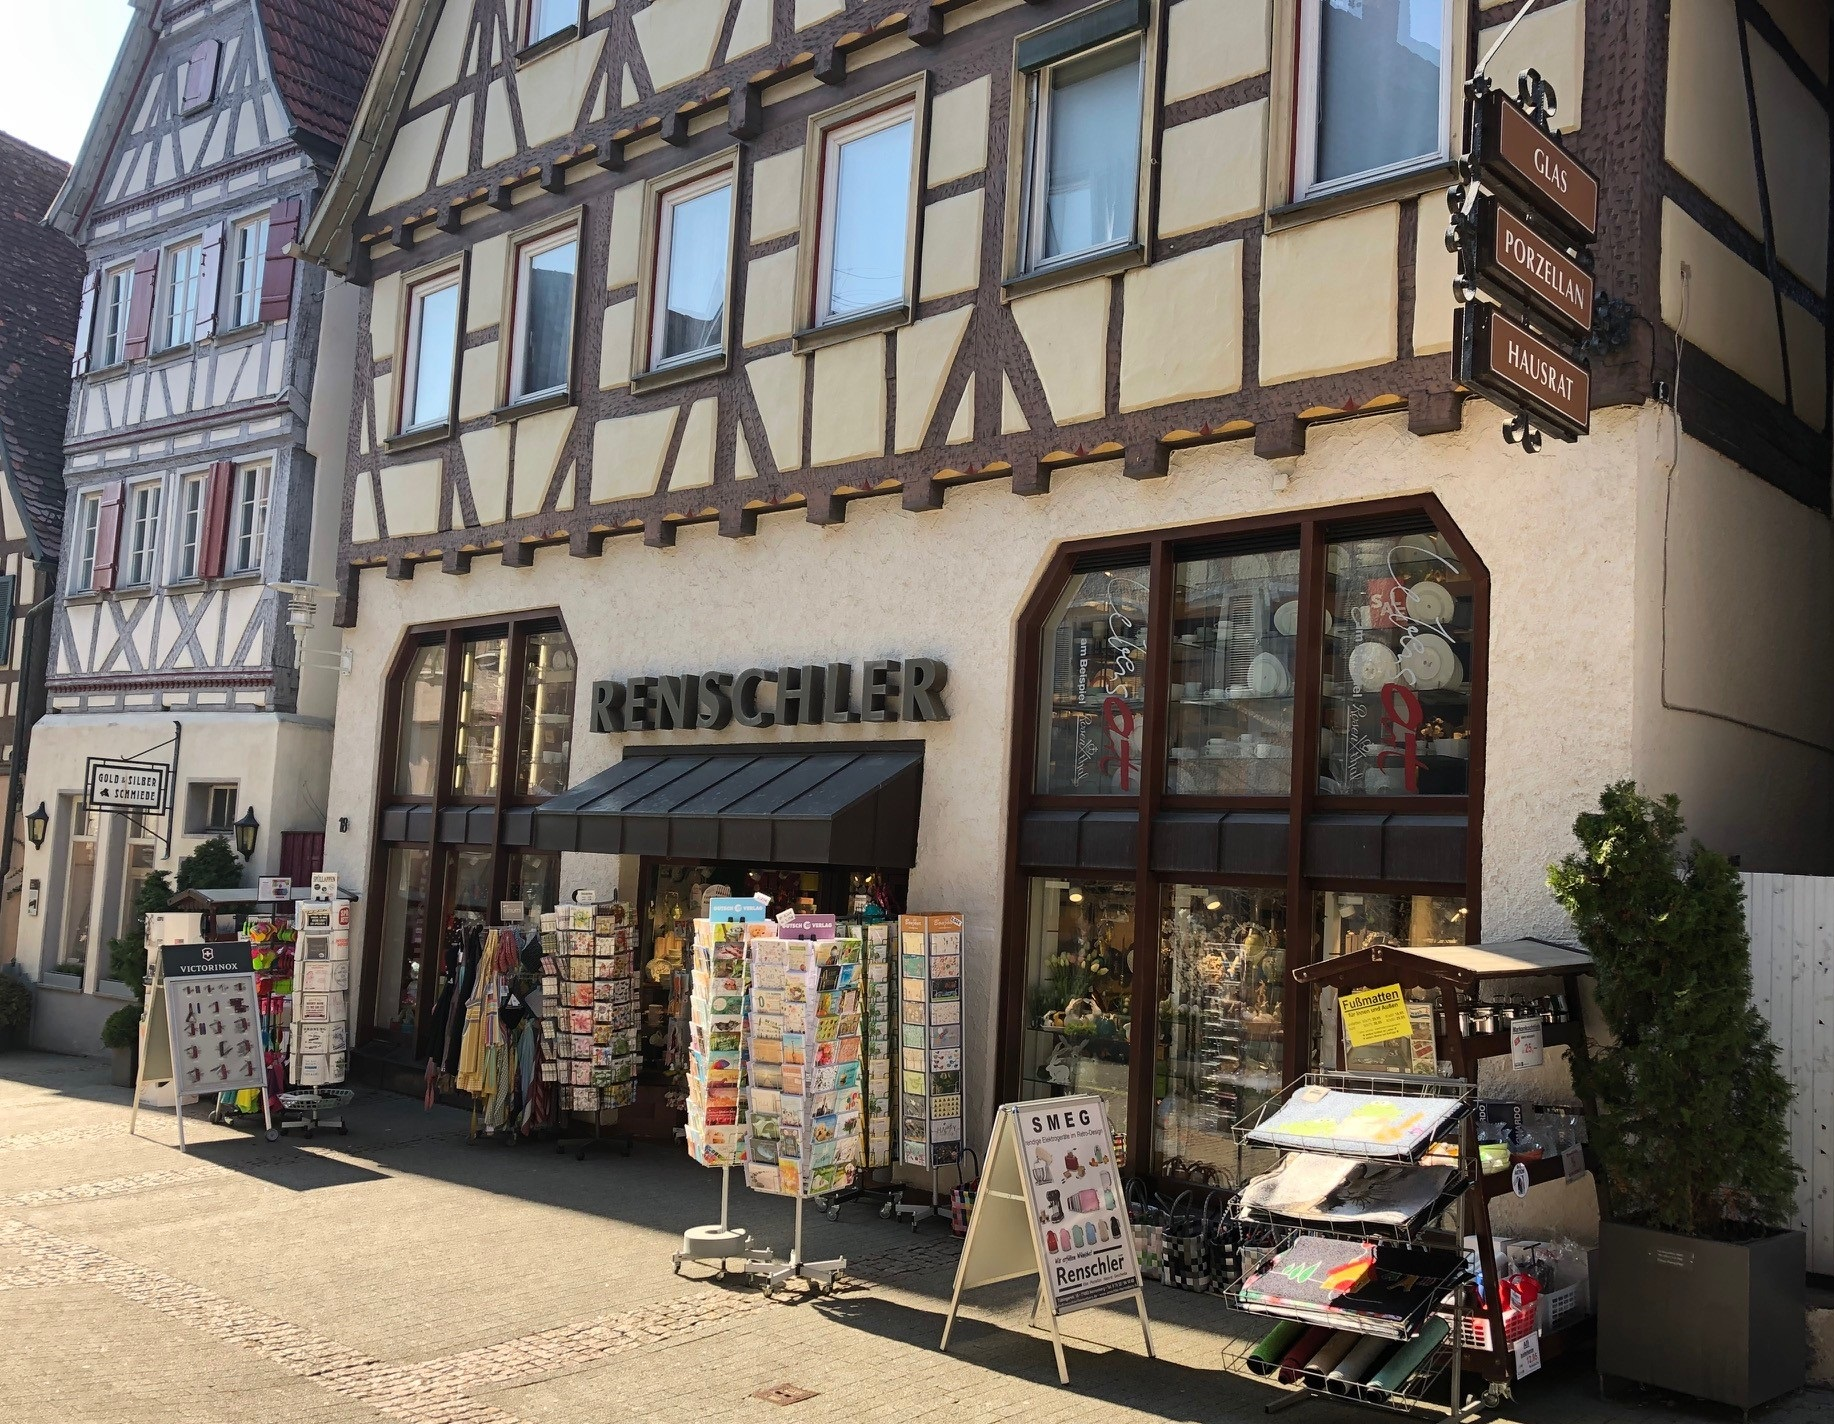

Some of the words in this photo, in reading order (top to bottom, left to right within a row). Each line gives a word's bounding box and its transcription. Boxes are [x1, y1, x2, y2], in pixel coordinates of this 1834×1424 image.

[1534, 148, 1568, 193] GLAS
[1505, 229, 1585, 310] PORZELLAN
[1507, 340, 1574, 401] HAUSRAT
[1370, 593, 1408, 621] SALE
[1080, 638, 1088, 657] am
[590, 658, 951, 733] RENSCHLER
[1078, 659, 1088, 704] Beispiel
[98, 773, 119, 784] GOLD
[127, 776, 157, 787] SILBER
[114, 789, 156, 801] SCHMIEDE
[180, 962, 238, 973] VICTORINOX
[1342, 990, 1399, 1010] Fußmatten
[1032, 1109, 1091, 1133] SMEG
[1056, 1255, 1124, 1286] Renschler
